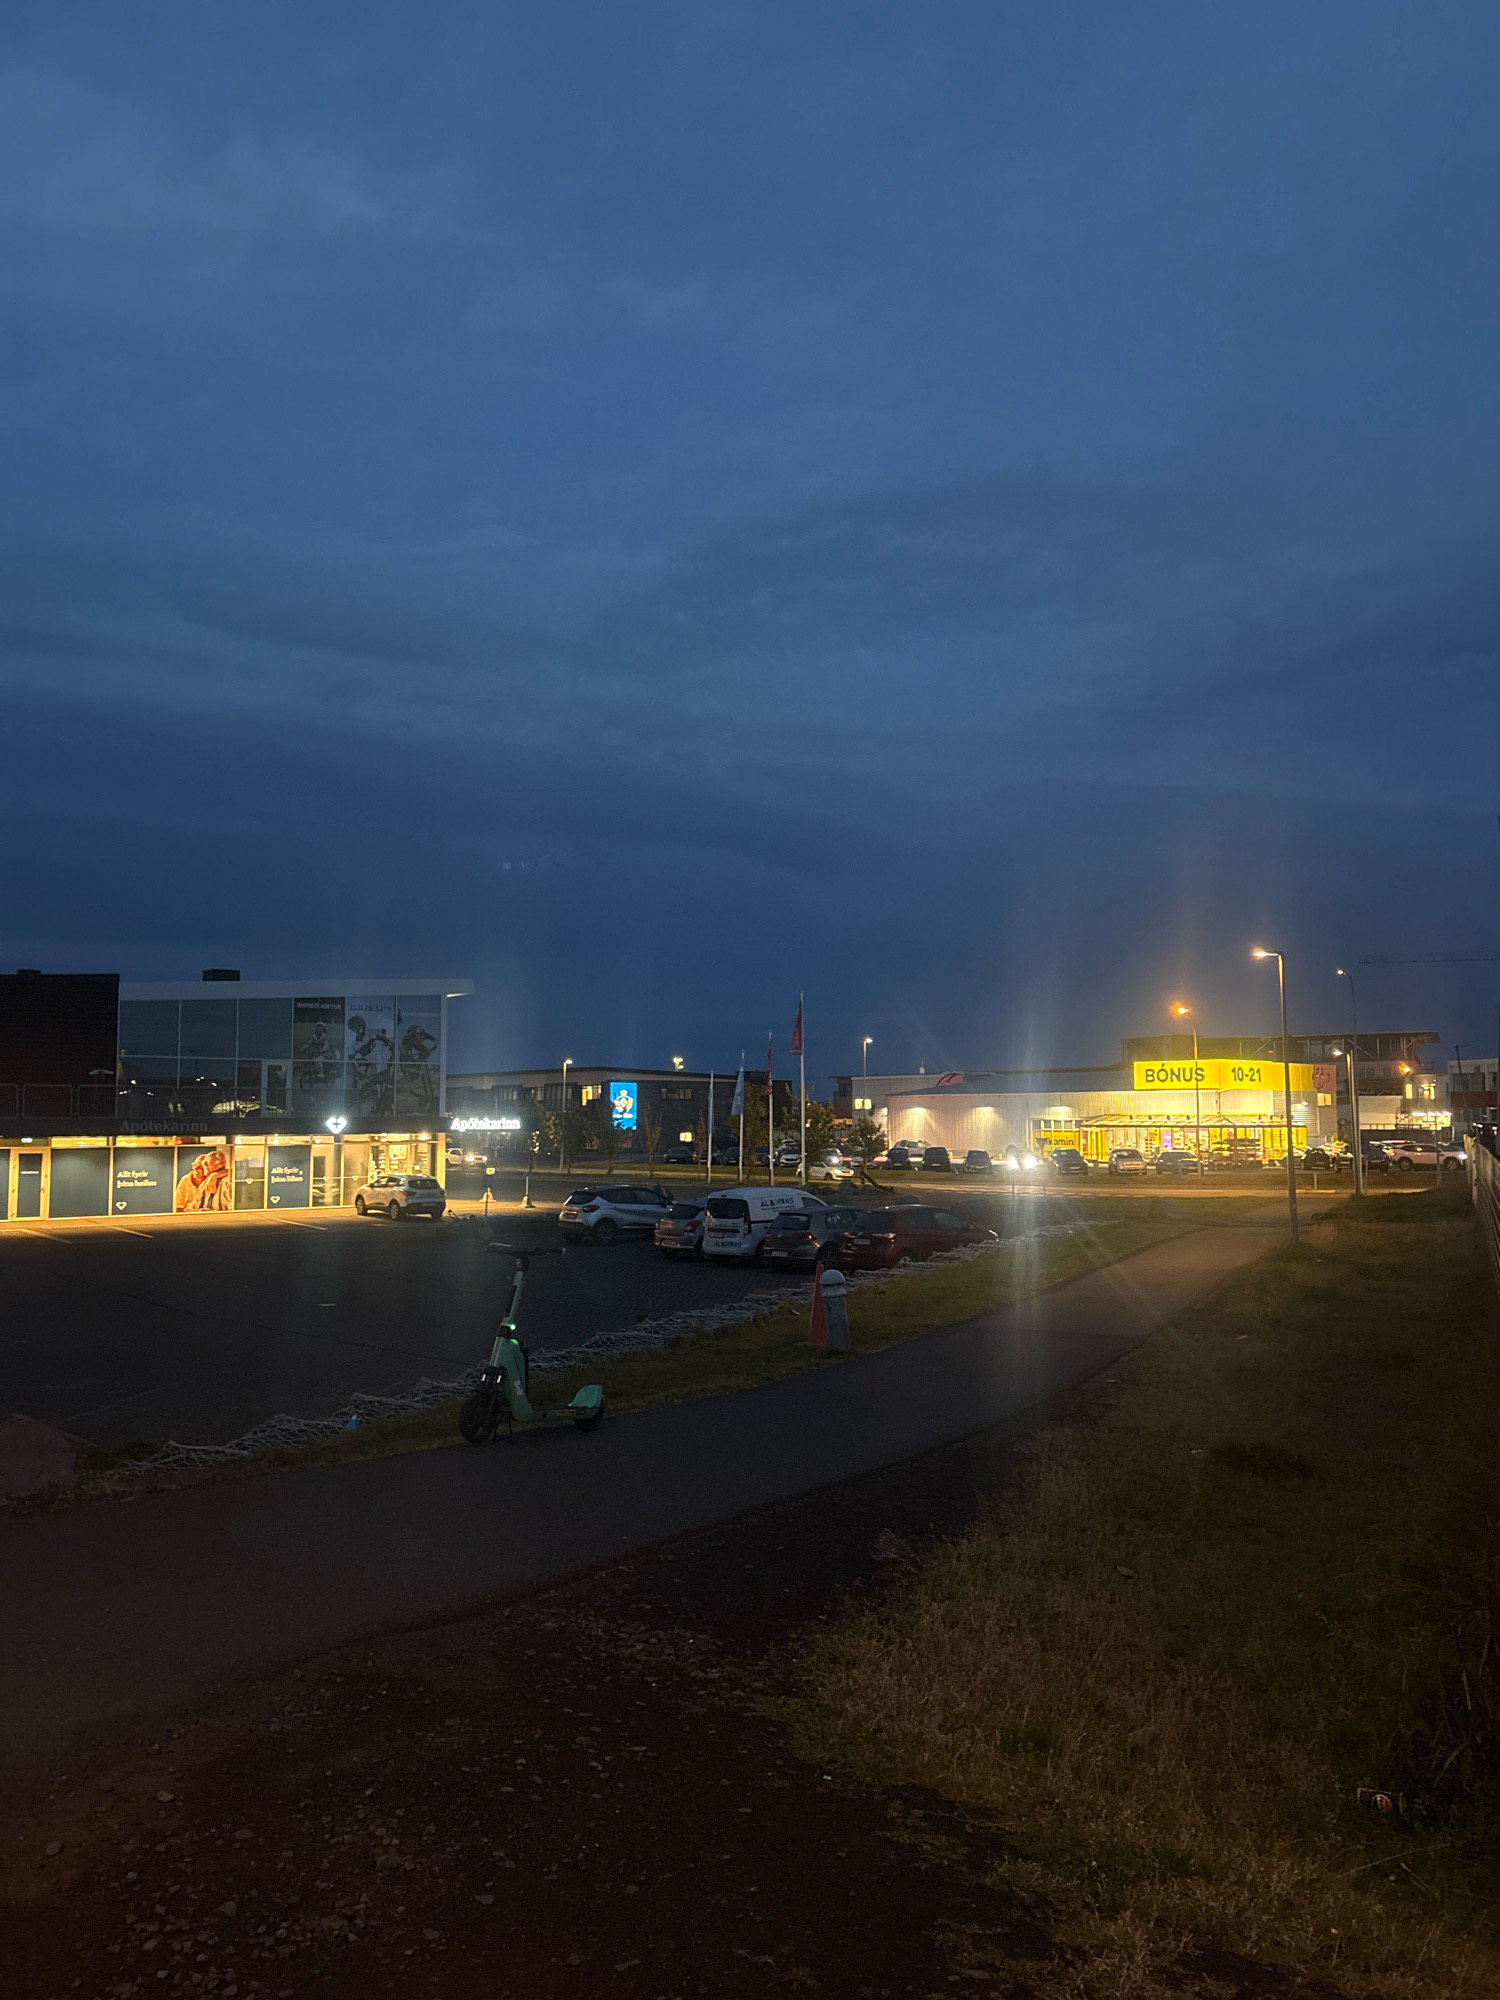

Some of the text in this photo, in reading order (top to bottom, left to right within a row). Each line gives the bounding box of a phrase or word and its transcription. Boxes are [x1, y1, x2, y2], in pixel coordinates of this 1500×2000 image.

[1145, 1063, 1205, 1083] BÓNUS
[1231, 1066, 1262, 1083] 10-21
[120, 1119, 208, 1134] Apótekarinn
[450, 1117, 521, 1132] Apótekarinn
